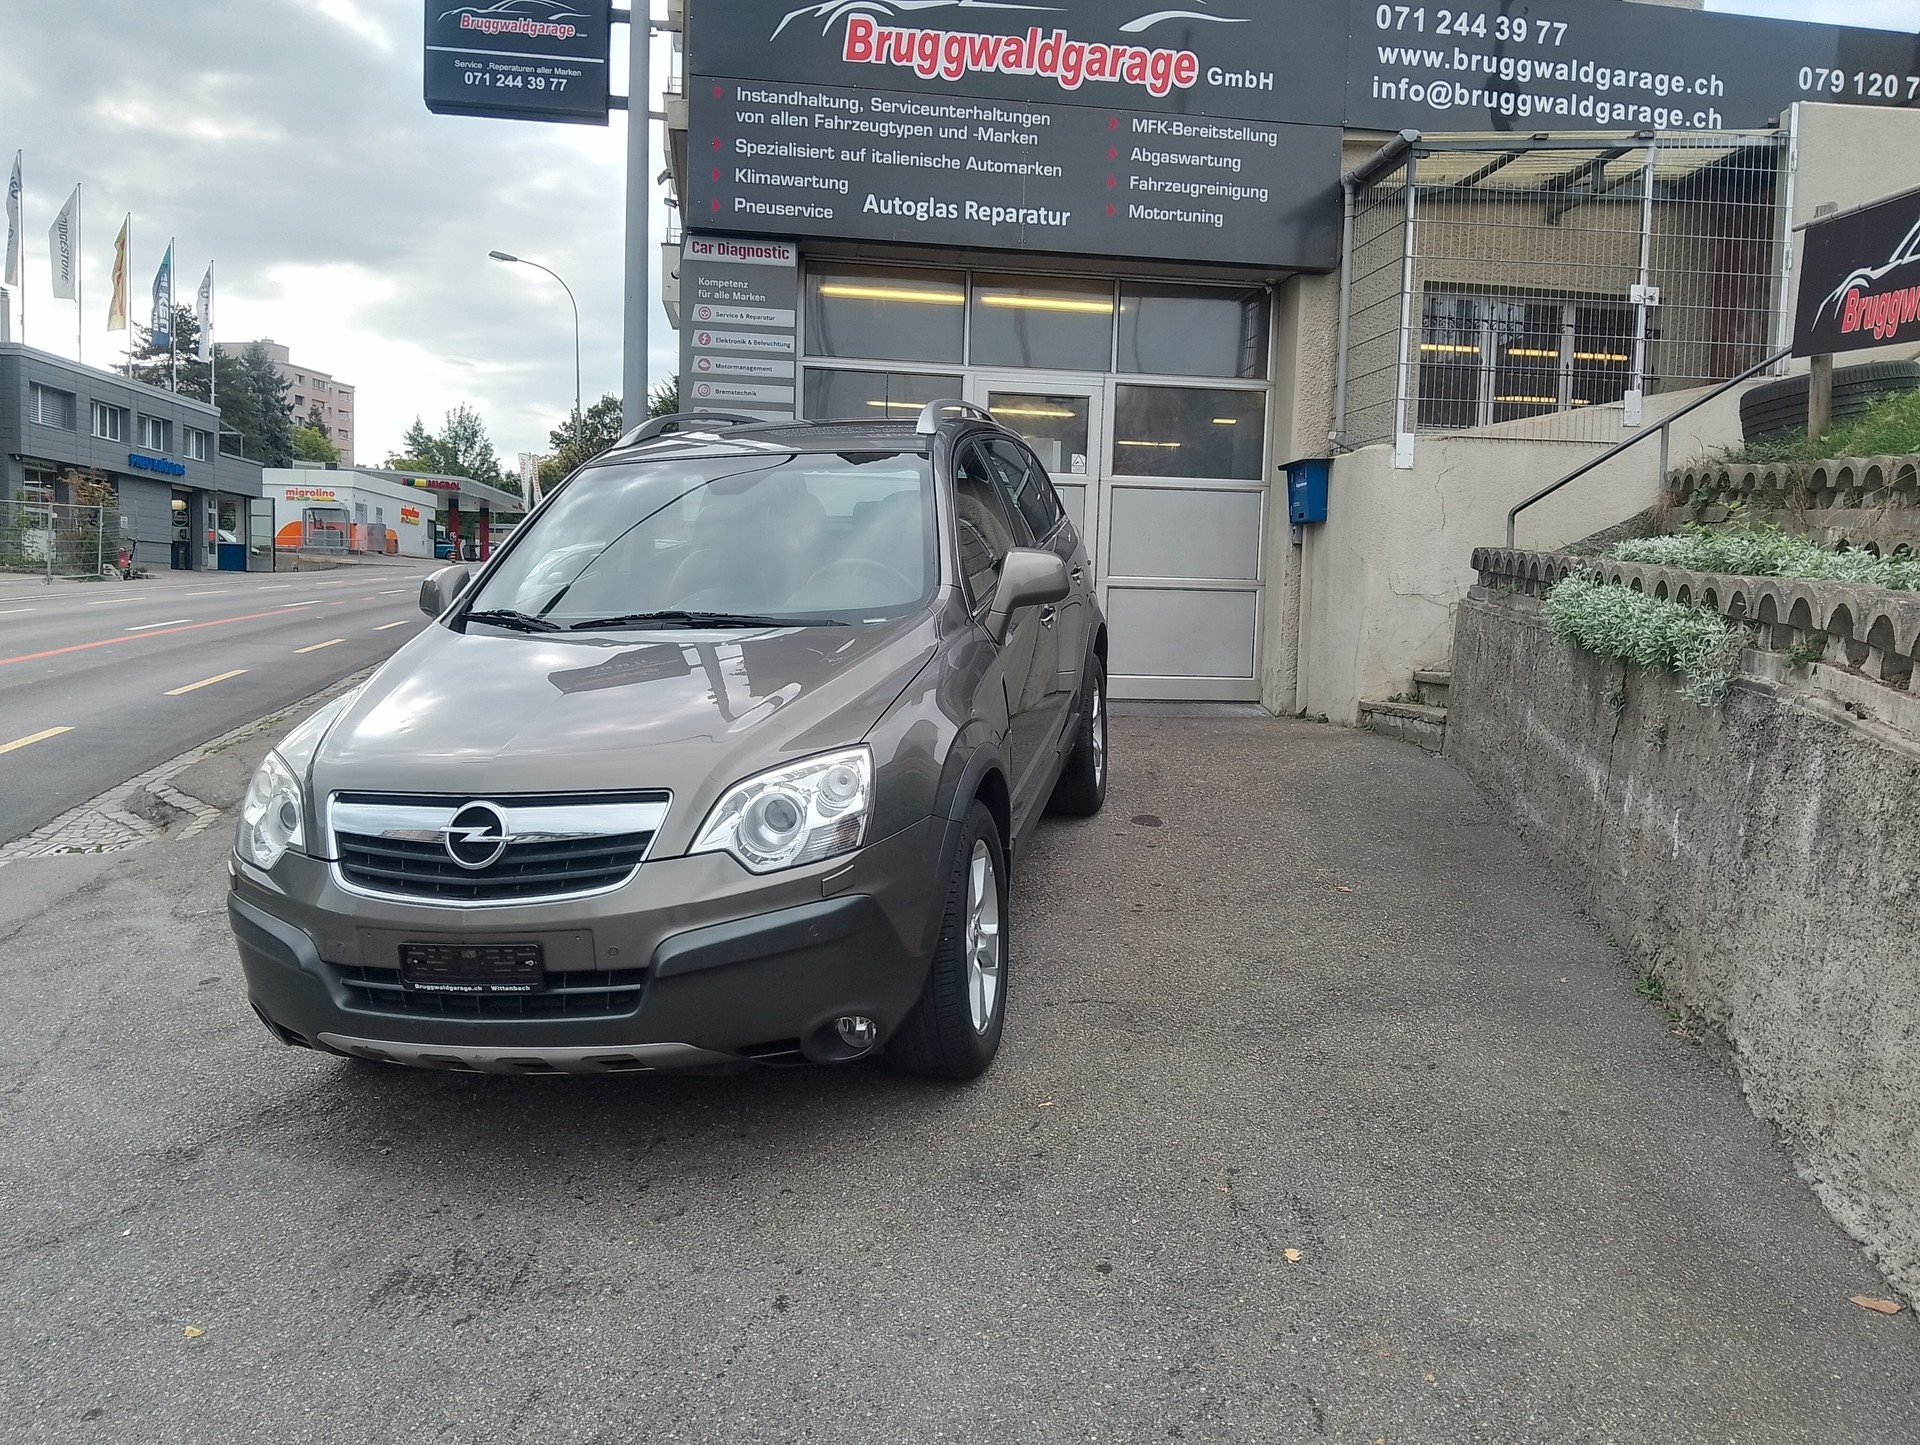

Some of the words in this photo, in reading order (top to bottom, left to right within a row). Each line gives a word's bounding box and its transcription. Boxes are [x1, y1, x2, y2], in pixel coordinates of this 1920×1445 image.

[460, 12, 576, 40] Bruggwaldgarage
[1376, 4, 1425, 32] 071
[1435, 9, 1487, 38] 244
[1495, 15, 1527, 42] 39
[1536, 20, 1568, 46] 77
[842, 13, 1199, 97] Bruggwaldgarage
[1207, 66, 1274, 91] GmbH
[454, 60, 482, 69] Service
[536, 66, 552, 74] aller
[554, 68, 582, 76] Marken
[1377, 46, 1724, 97] www.bruggwaldgarage.ch
[464, 72, 490, 86] 071
[496, 74, 523, 88] 244
[527, 76, 545, 90] 39
[550, 78, 568, 92] 77
[1798, 66, 1845, 93] 079
[1853, 72, 1898, 98] 120
[736, 86, 864, 114] Instandhaltung,
[870, 97, 1050, 127] Serviceunterhaltungen
[1372, 75, 1722, 130] info@bruggwaldgarage.ch
[736, 112, 764, 124] von
[770, 110, 808, 127] allen
[814, 114, 932, 138] Fahrzeugtypen
[939, 126, 968, 140] und
[972, 127, 1038, 145] -Marken
[1132, 118, 1278, 146] MFK-Bereitstellung
[735, 138, 835, 160] Spezialisiert
[840, 148, 866, 162] auf
[871, 148, 960, 170] italienische
[966, 156, 1062, 177] Automarken
[1130, 147, 1242, 172] Abgaswartung
[735, 168, 849, 194] Klimawartung
[1129, 175, 1268, 202] Fahrzeugreinigung
[734, 197, 834, 219] Pneuservice
[862, 193, 958, 222] Autoglas
[964, 200, 1070, 226] Reparatur
[1128, 204, 1224, 228] Motortuning
[692, 241, 714, 254] Car
[718, 242, 790, 260] Diagnostic
[698, 277, 748, 288] Kompetenz
[698, 290, 711, 298] für
[714, 290, 730, 300] alle
[732, 292, 766, 302] Marken
[754, 340, 791, 348] Beleuchtung
[716, 363, 772, 372] Motormanagement
[716, 388, 758, 396] Bremstechnik
[286, 487, 336, 498] migrolino
[414, 983, 483, 992] Bruggwaldgarage.ch
